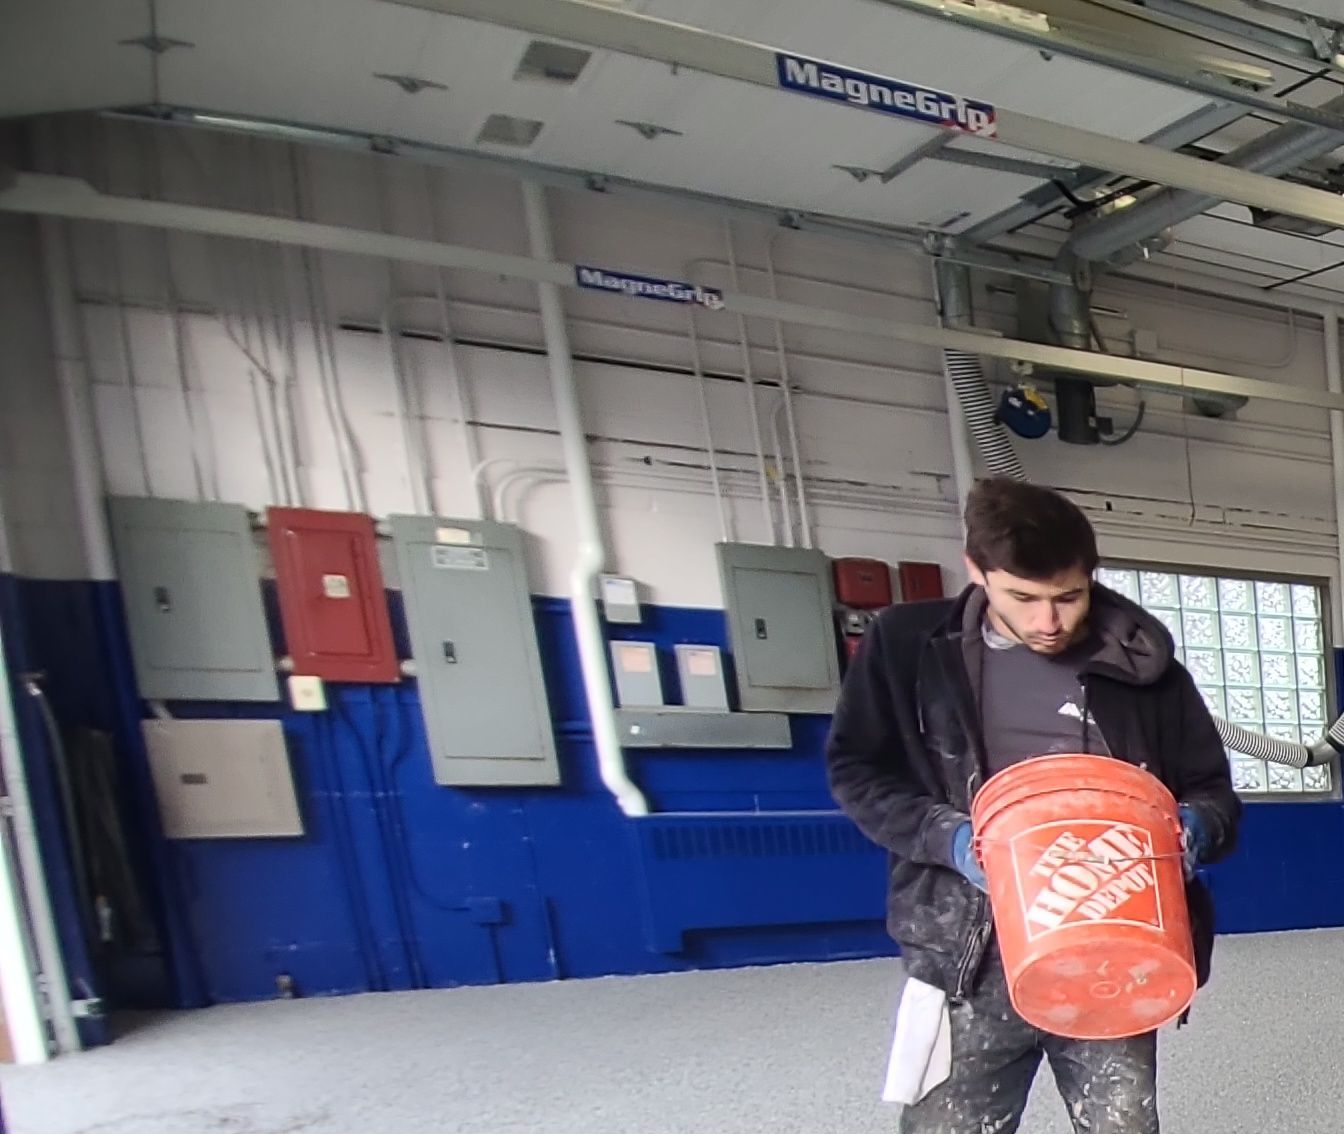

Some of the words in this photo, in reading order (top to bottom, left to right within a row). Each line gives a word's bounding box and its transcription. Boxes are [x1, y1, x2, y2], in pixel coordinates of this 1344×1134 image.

[785, 58, 997, 137] MagneGrip
[1026, 824, 1152, 929] HOME
[1028, 831, 1087, 878] THE
[1076, 863, 1154, 920] DEPOT
